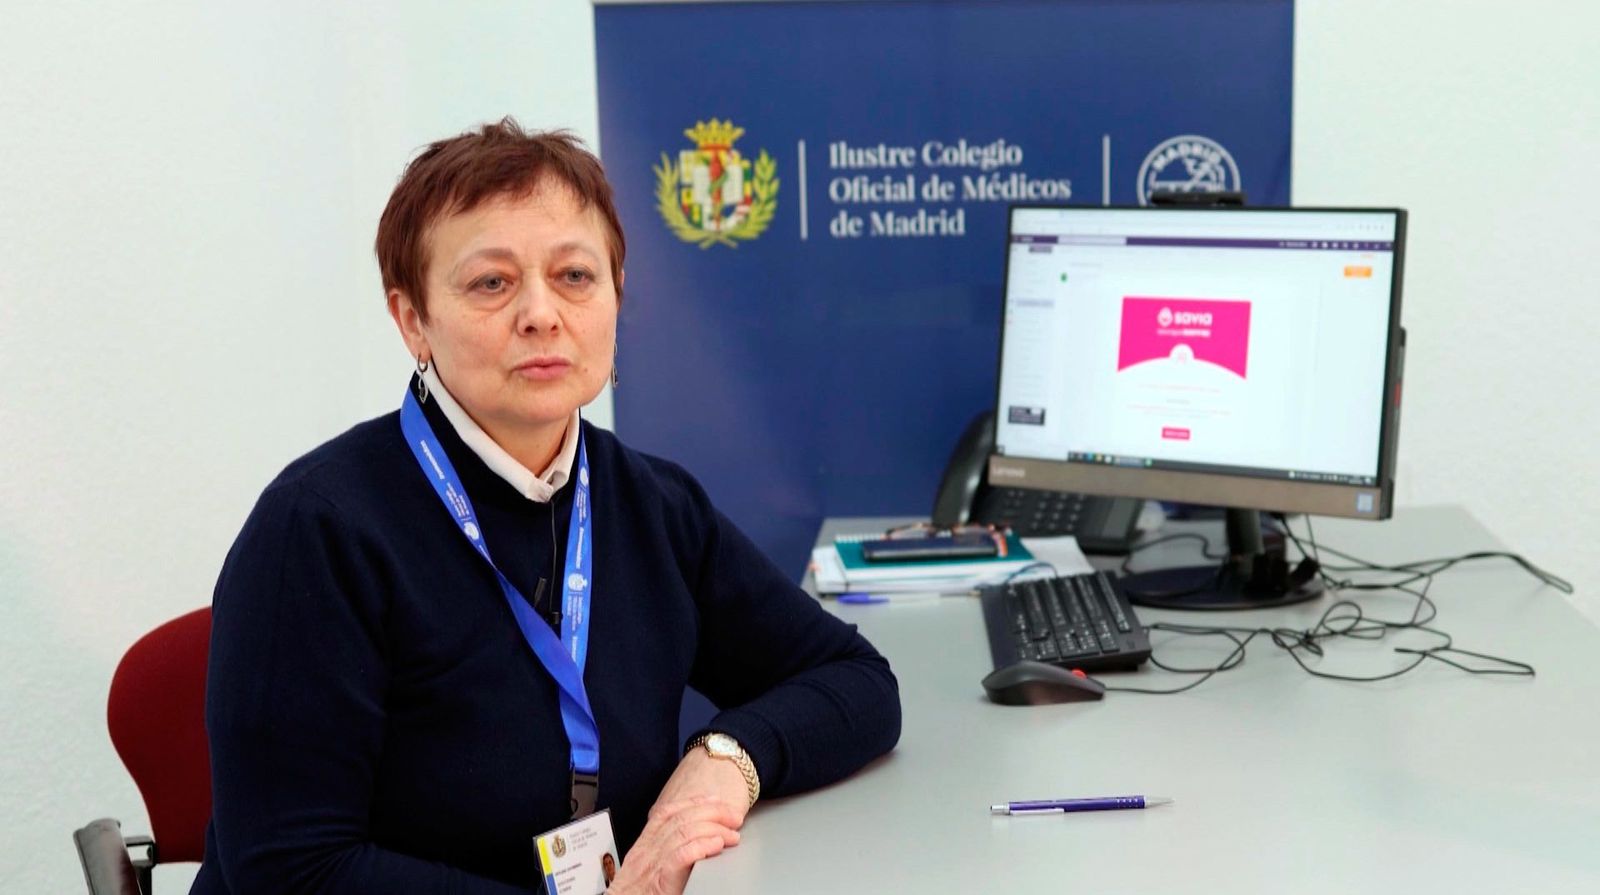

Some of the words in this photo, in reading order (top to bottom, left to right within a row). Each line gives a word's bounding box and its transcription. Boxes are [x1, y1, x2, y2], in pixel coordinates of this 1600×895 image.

[829, 141, 916, 168] Ilustre
[922, 139, 1023, 170] Colegio
[1152, 142, 1222, 172] MADRID
[828, 174, 915, 202] Oficial
[922, 174, 955, 202] de
[962, 173, 1072, 201] Médicos
[829, 210, 864, 238] de
[871, 208, 966, 236] Madrid
[1174, 311, 1213, 327] savia
